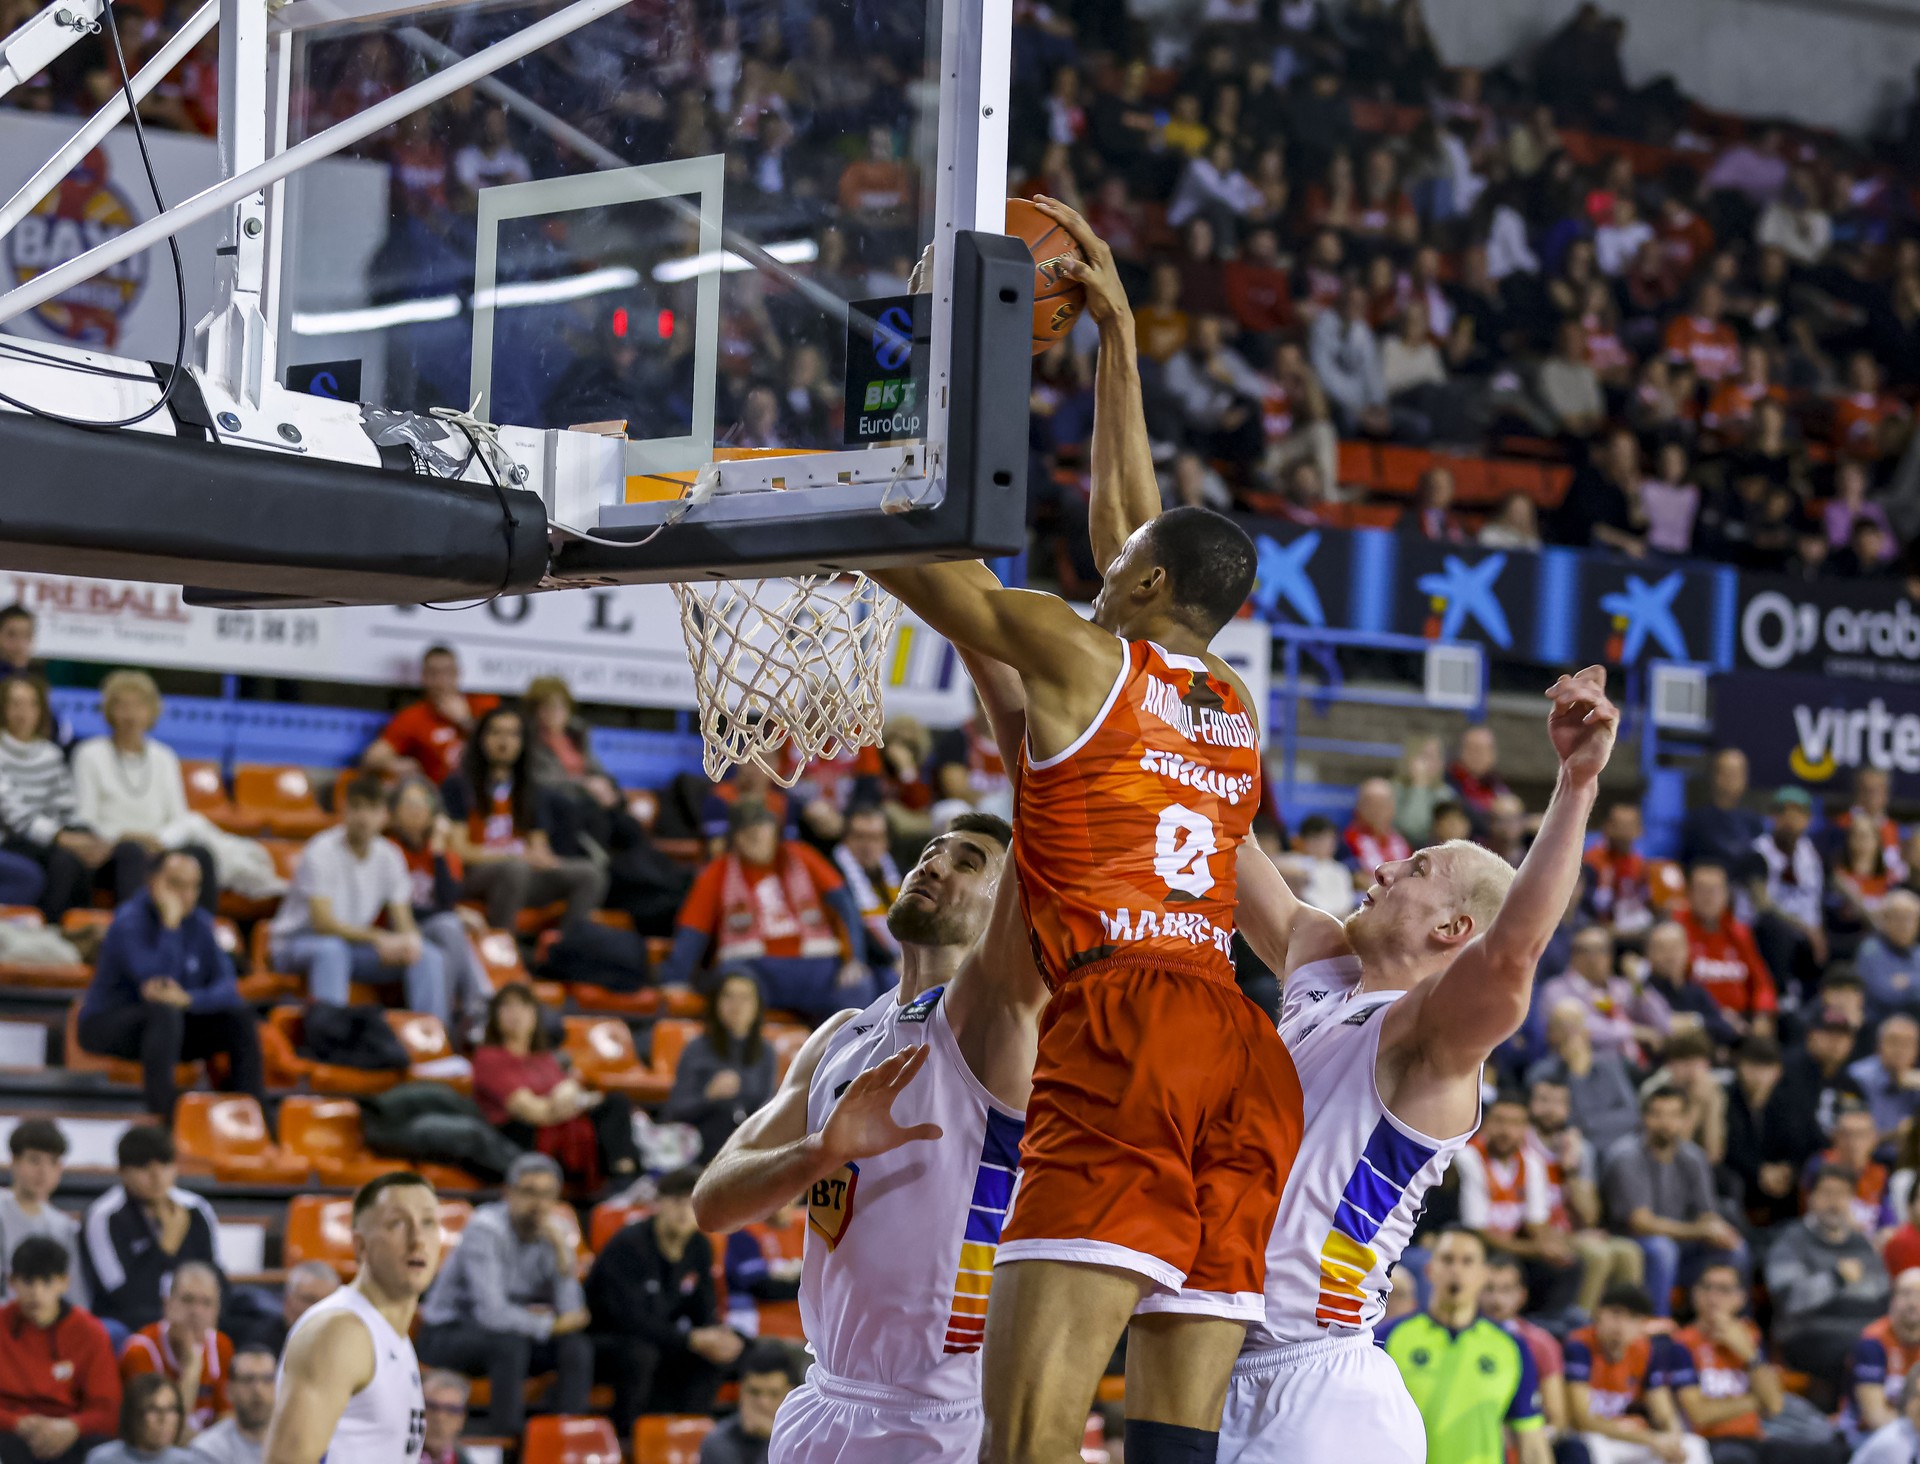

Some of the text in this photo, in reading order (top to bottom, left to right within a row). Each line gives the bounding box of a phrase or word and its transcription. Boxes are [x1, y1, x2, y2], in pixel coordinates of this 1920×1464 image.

[865, 382, 916, 406] BKT
[859, 412, 921, 436] EuroCup
[11, 575, 191, 624] TREBALL
